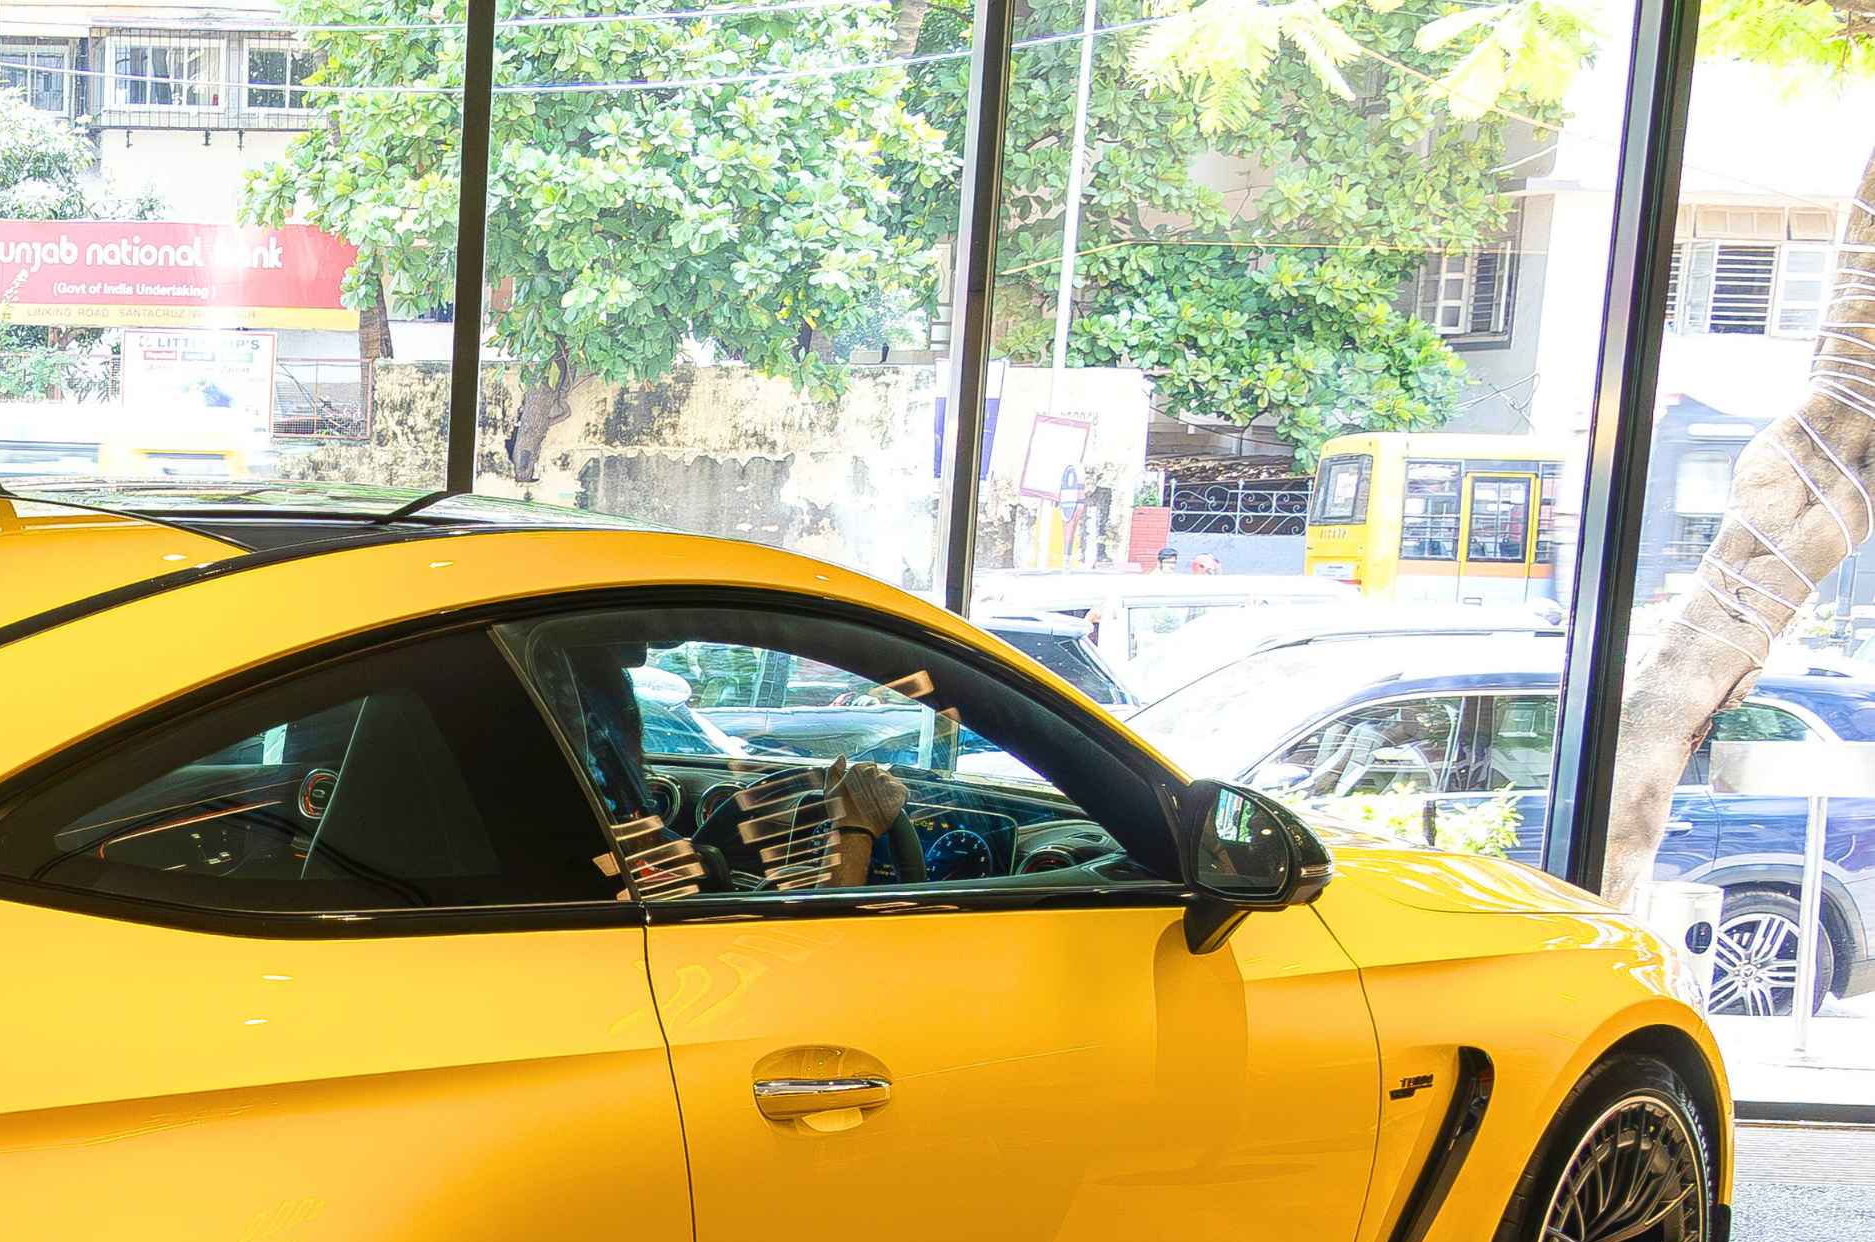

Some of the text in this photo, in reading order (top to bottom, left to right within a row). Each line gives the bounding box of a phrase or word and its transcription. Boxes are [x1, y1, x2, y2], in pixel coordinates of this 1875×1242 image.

[86, 235, 204, 267] national
[89, 283, 101, 295] of
[104, 283, 133, 296] India
[78, 309, 110, 319] ROAD
